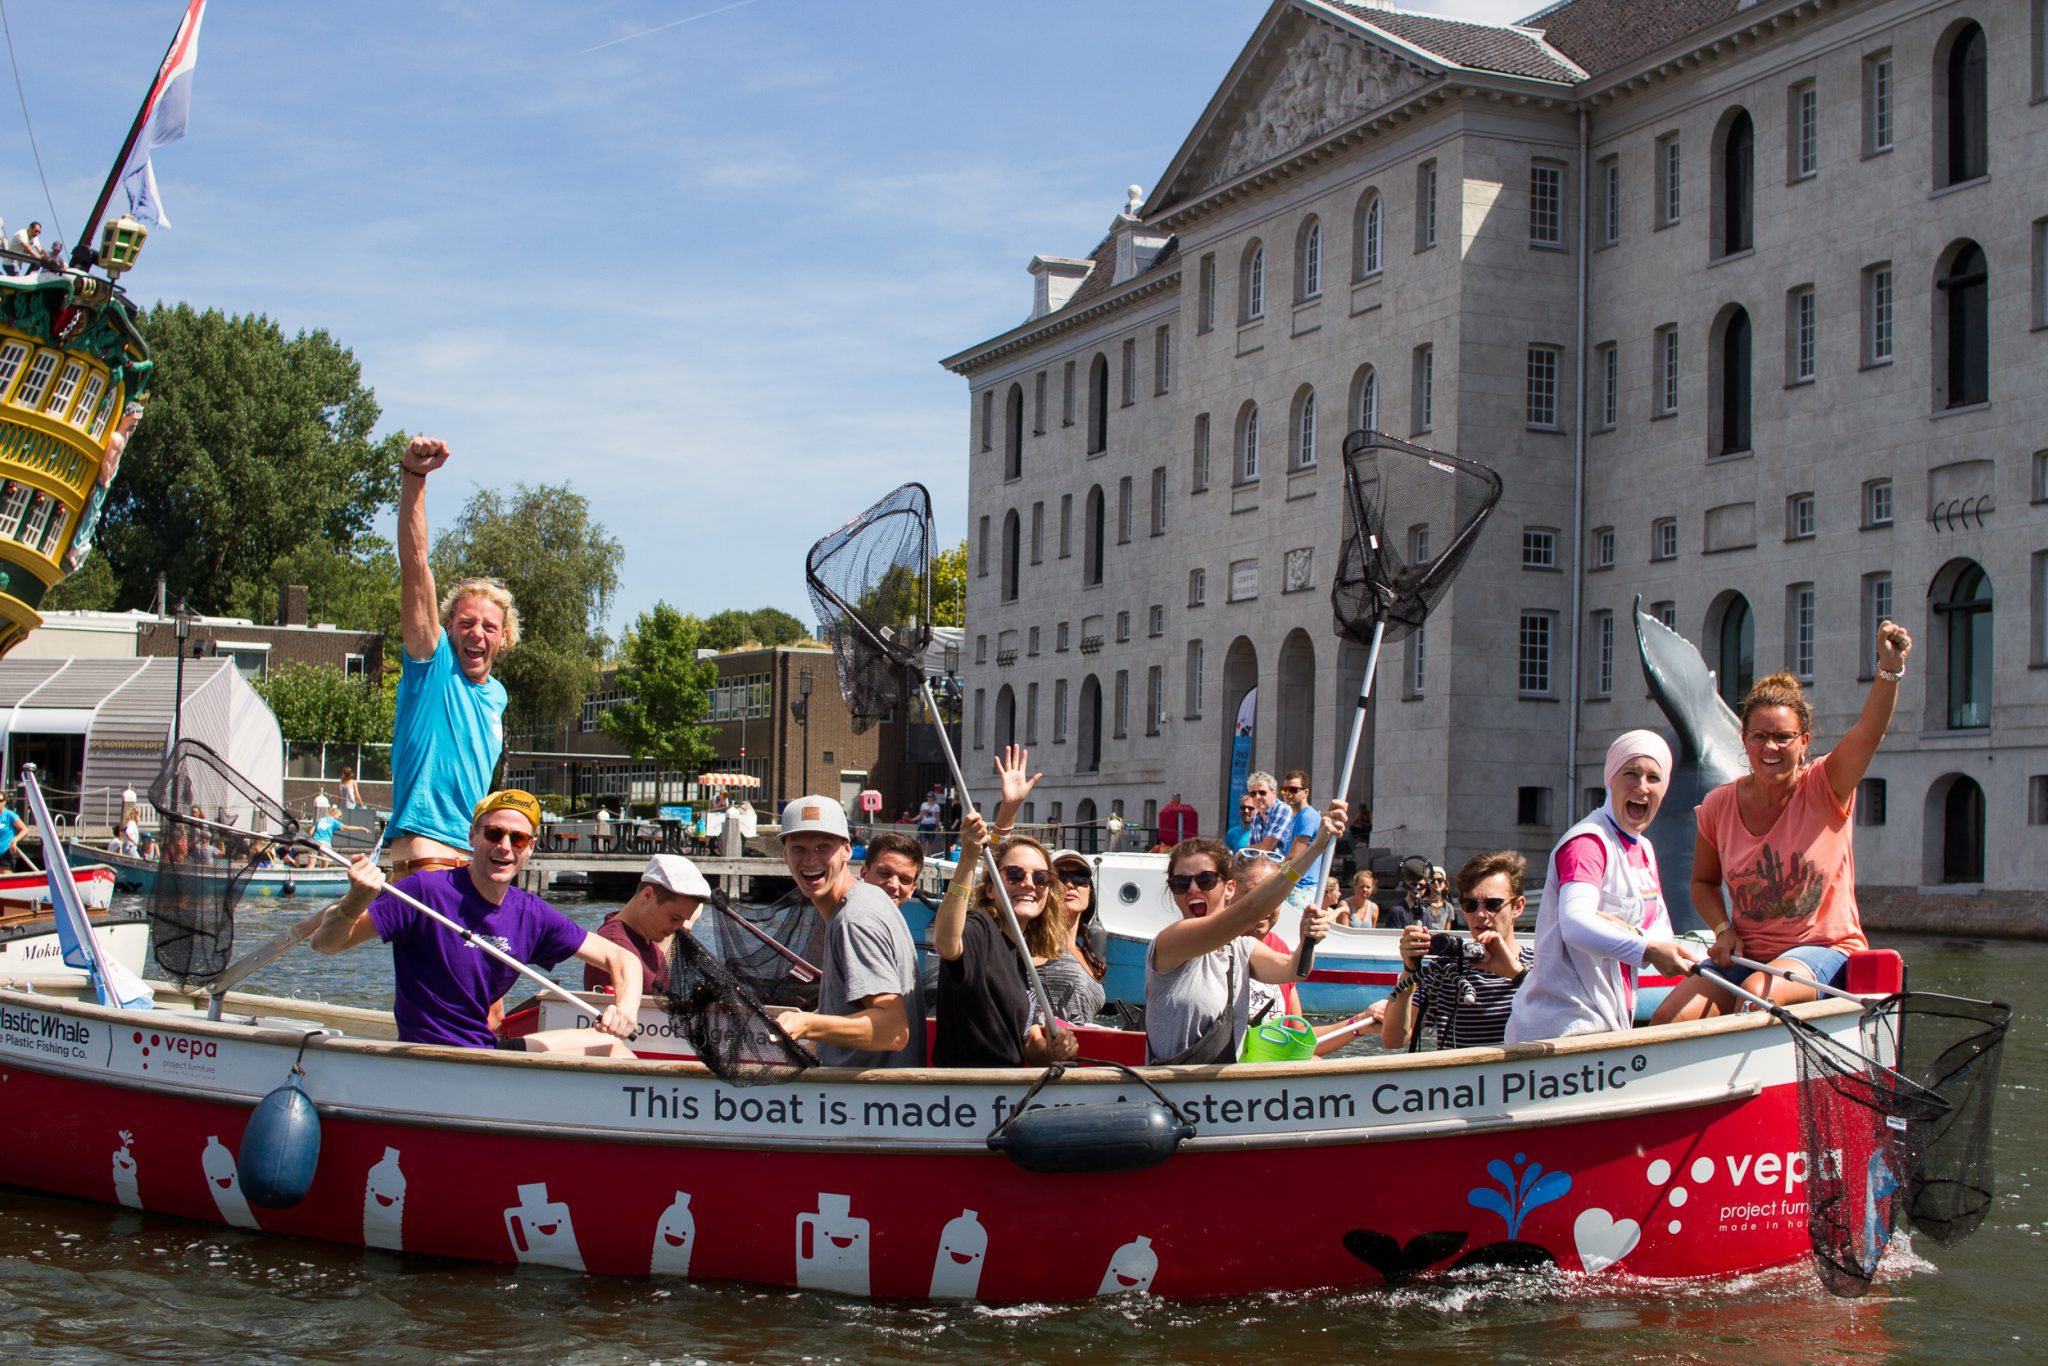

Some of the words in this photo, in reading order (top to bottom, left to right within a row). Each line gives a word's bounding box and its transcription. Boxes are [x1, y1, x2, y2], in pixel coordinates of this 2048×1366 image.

[22, 943, 63, 961] Moku
[6, 1034, 34, 1048] Plastic
[37, 1040, 69, 1058] Fishing
[72, 1046, 88, 1060] Co.
[165, 1035, 217, 1060] vepa
[623, 1086, 699, 1118] This
[715, 1089, 803, 1123] boat
[820, 1093, 847, 1125] is
[864, 1095, 976, 1127] made
[1117, 1089, 1355, 1124] sterdam
[1372, 1075, 1485, 1115] Canal
[1726, 1148, 1843, 1194] vepa
[1720, 1202, 1777, 1222] project
[1719, 1222, 1757, 1232] made
[1766, 1220, 1778, 1229] in
